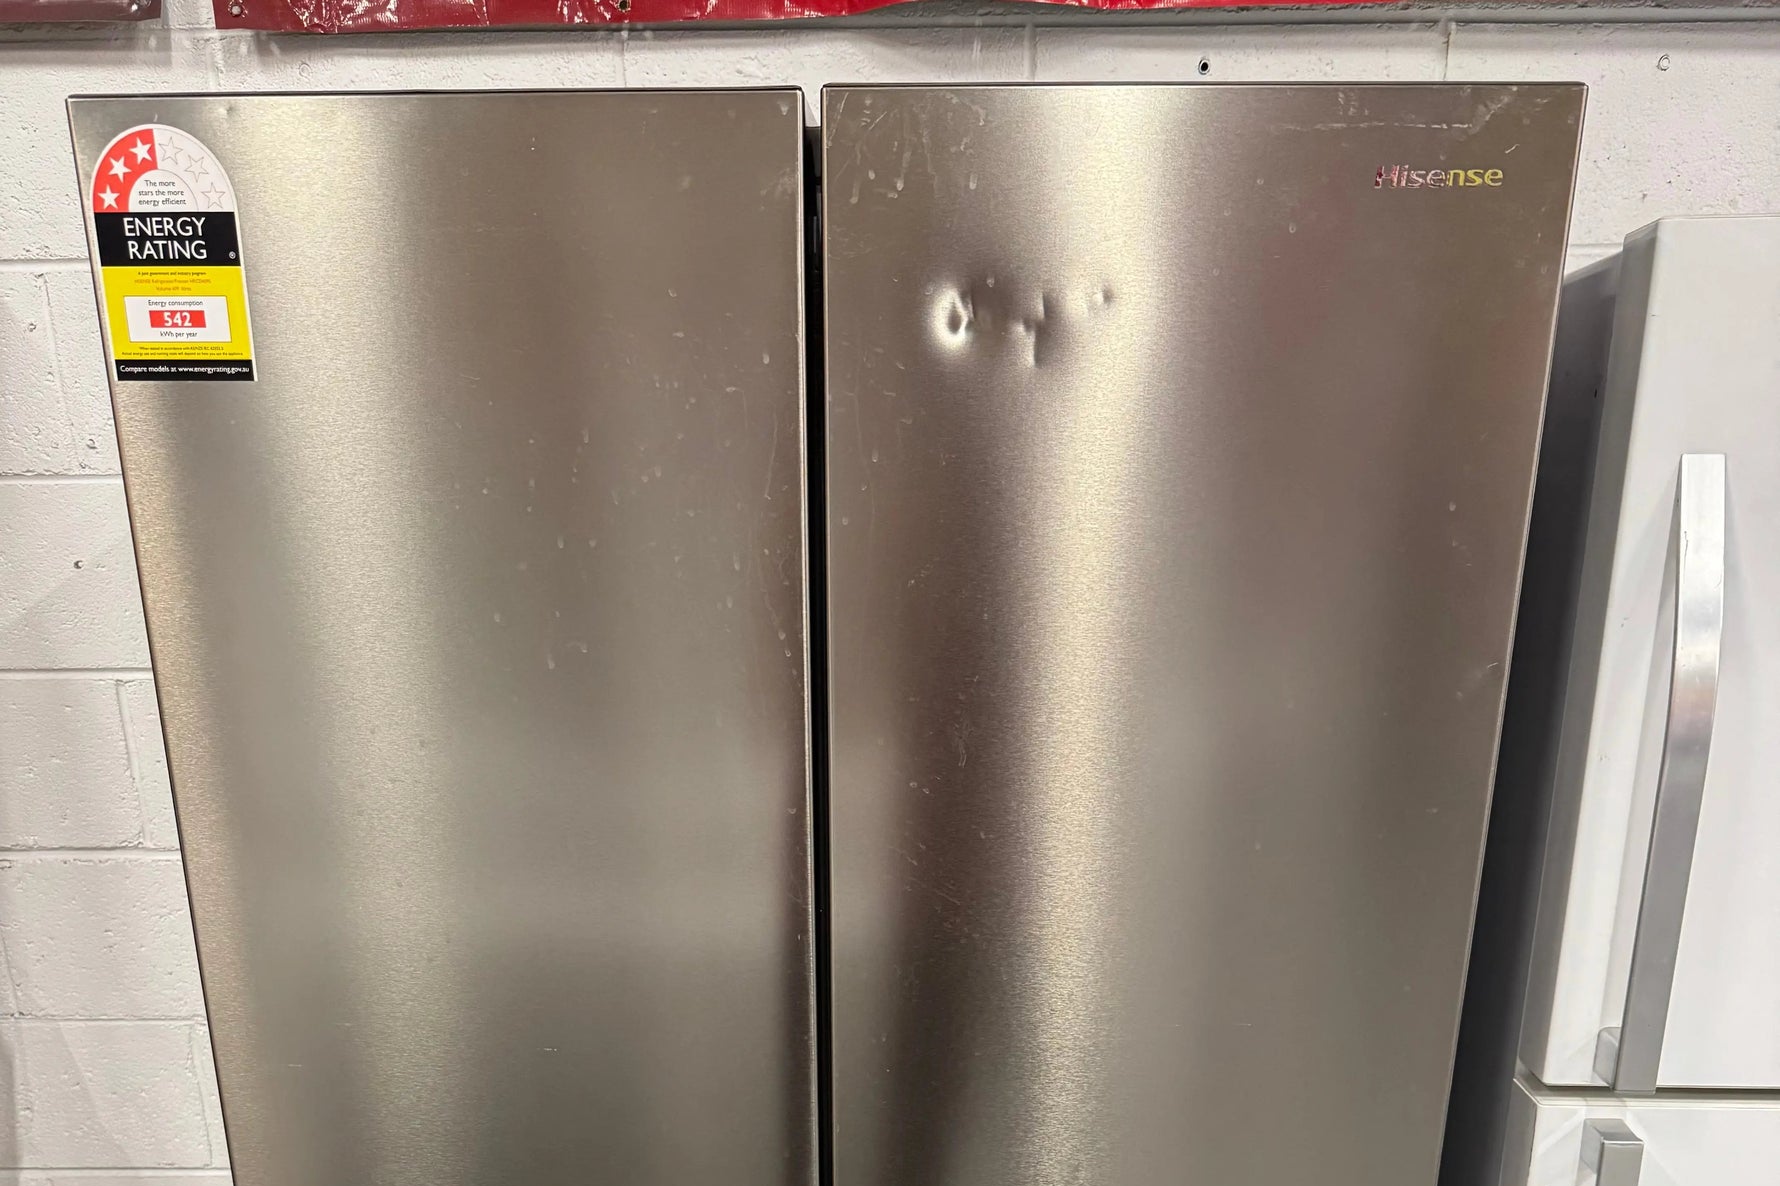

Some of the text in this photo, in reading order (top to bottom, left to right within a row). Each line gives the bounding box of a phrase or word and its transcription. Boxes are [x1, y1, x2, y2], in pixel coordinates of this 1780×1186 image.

[1375, 164, 1504, 189] Hisense
[144, 179, 157, 187] The
[161, 197, 187, 205] efficient
[123, 217, 205, 236] ENERGY
[128, 240, 207, 259] RATING
[148, 299, 167, 307] Energy
[164, 312, 192, 326] 542
[119, 365, 148, 374] Compare
[177, 365, 250, 374] www.energyrating.gov.au
